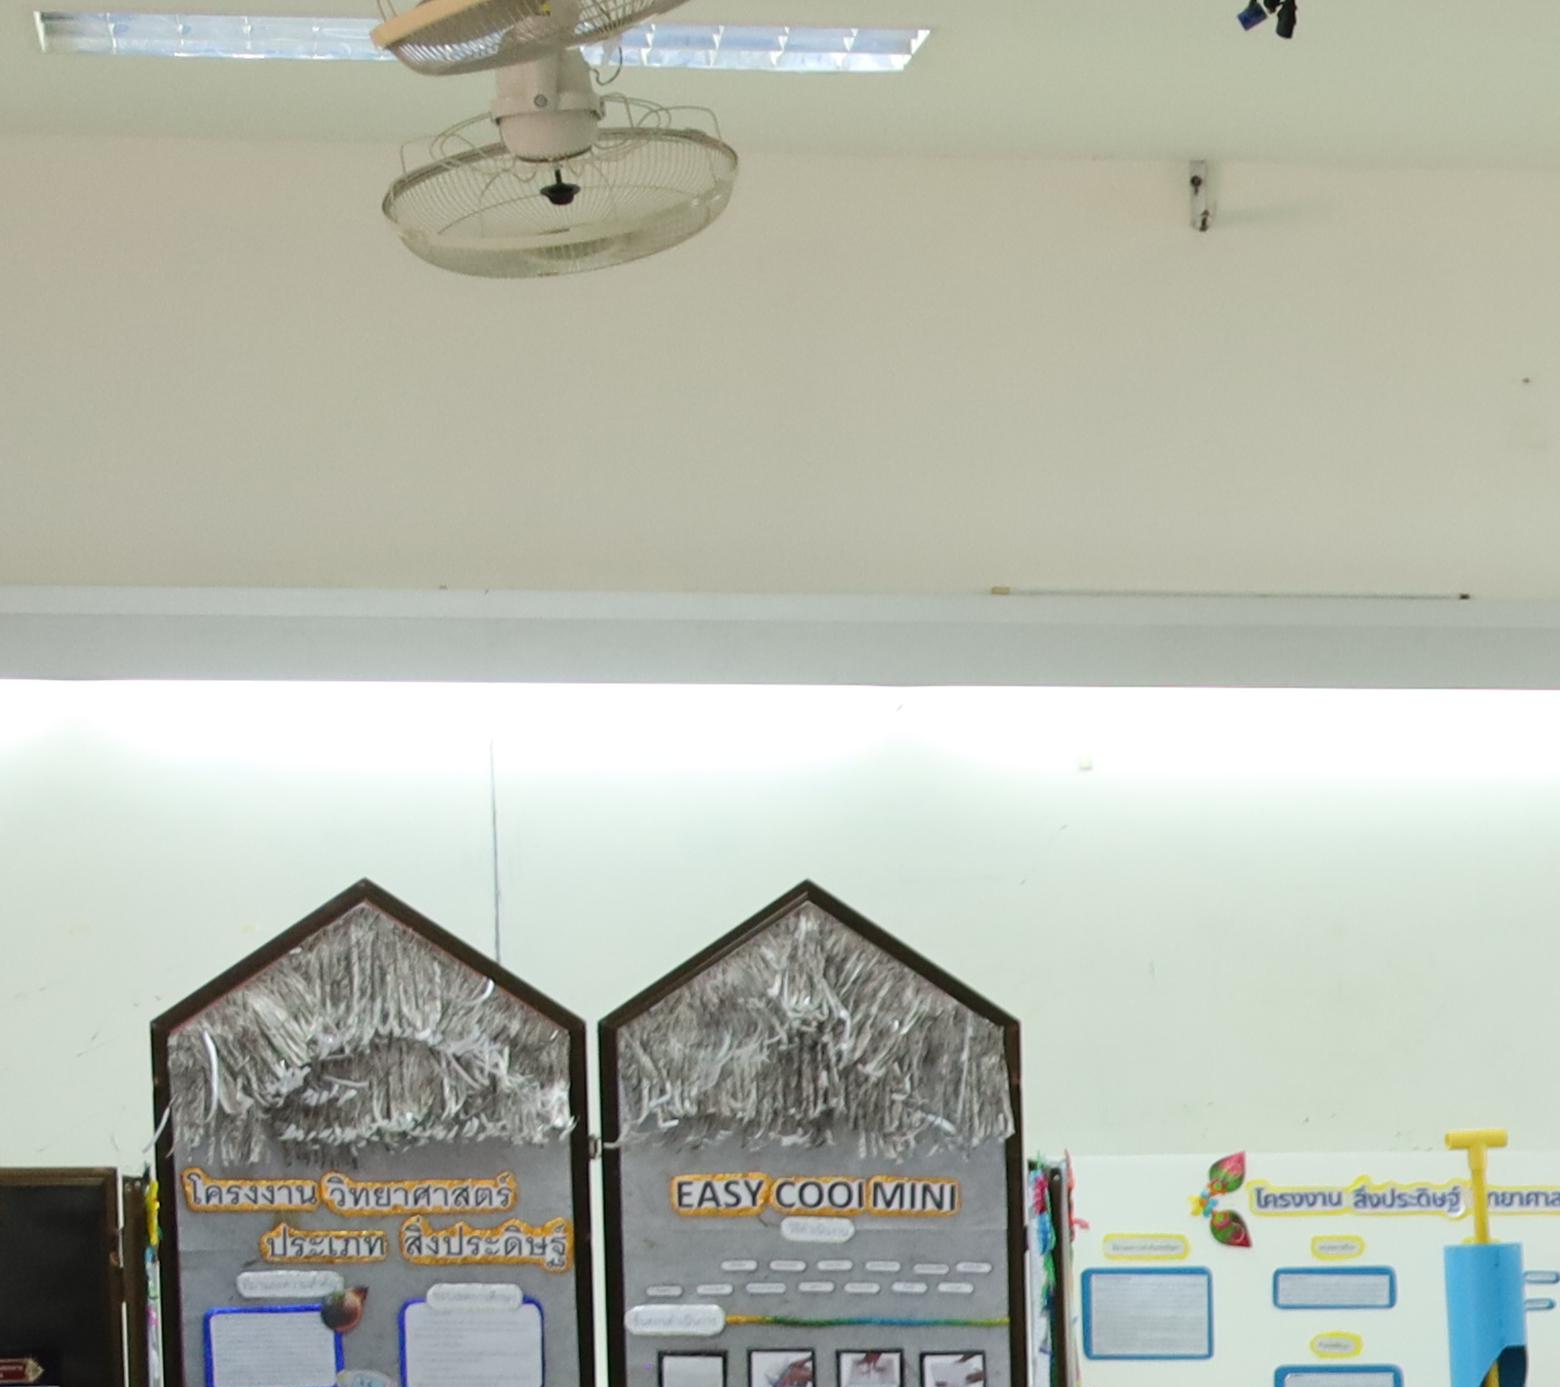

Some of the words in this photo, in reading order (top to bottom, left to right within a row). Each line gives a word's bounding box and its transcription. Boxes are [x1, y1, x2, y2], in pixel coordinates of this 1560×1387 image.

[190, 1172, 317, 1206] โครงงาน
[327, 1172, 515, 1206] วิทยาศาสตร์
[676, 1180, 763, 1210] EASY
[873, 1182, 957, 1212] MINI
[1256, 1186, 1343, 1209] โครงงาน
[1353, 1184, 1462, 1214] สิ่งประดิษฐ์
[266, 1229, 386, 1259] ประเภท
[404, 1214, 568, 1269] สิ่งประดิษฐ์
